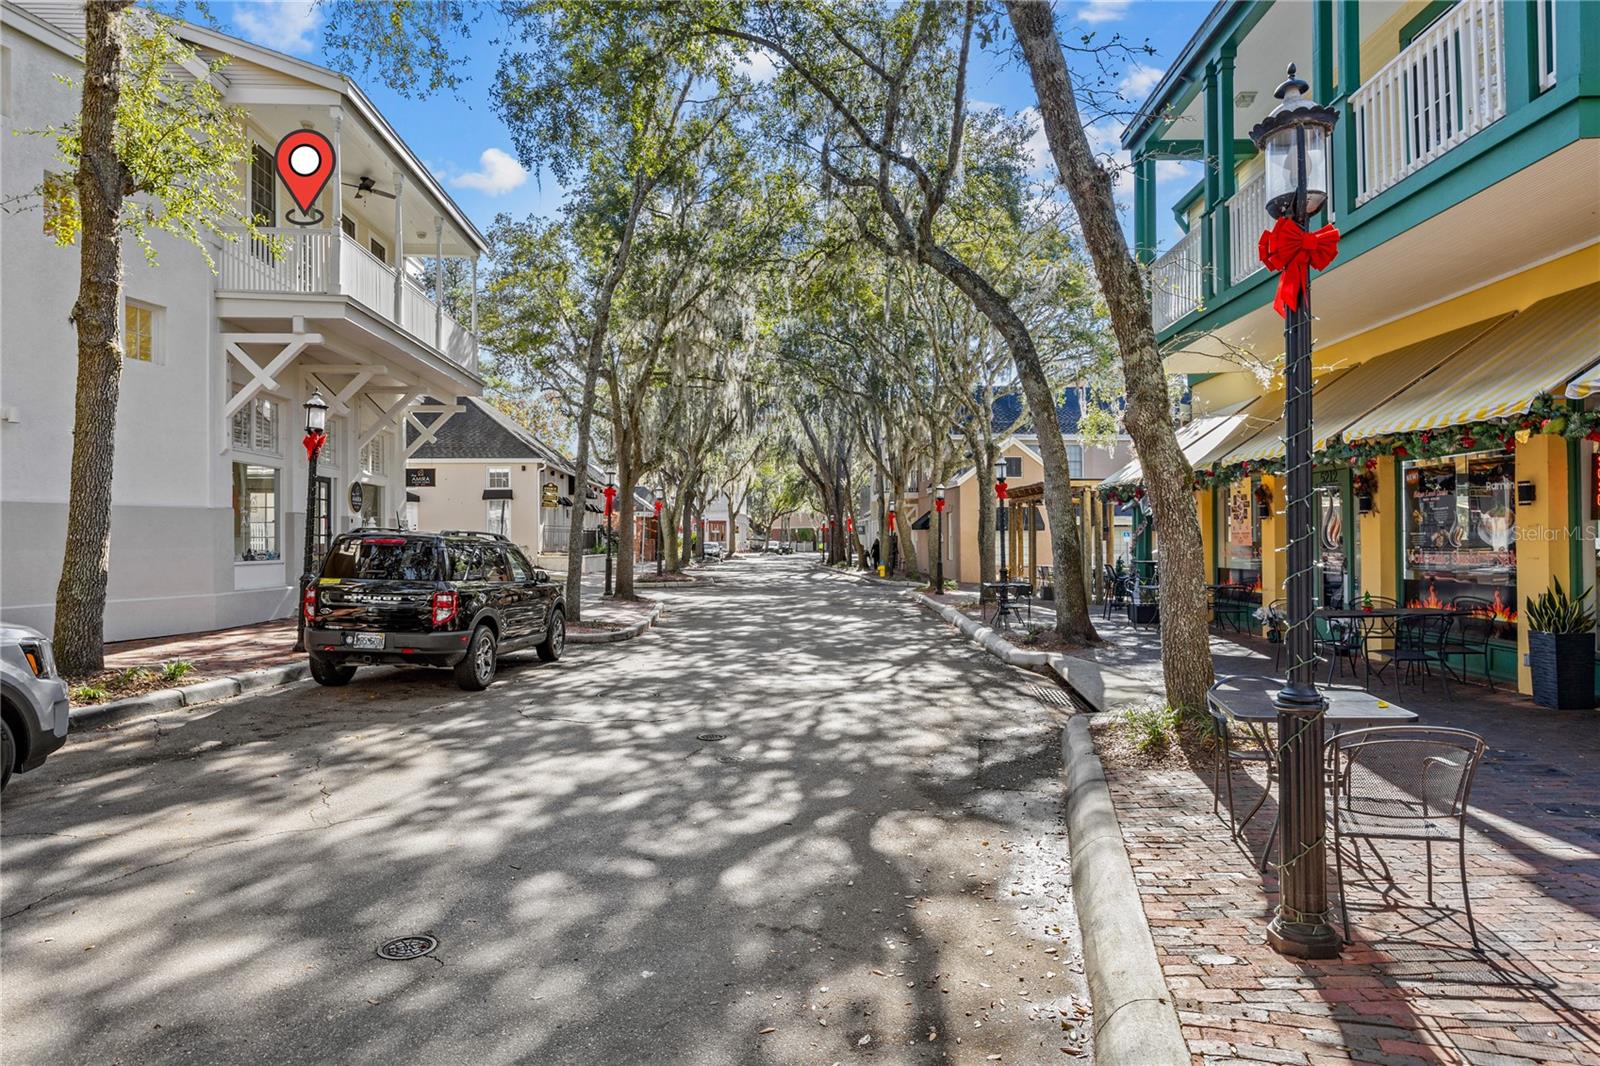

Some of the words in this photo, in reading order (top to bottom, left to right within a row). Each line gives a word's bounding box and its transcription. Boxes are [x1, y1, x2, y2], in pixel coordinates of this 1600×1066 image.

[1320, 471, 1338, 482] 5212
[1485, 481, 1515, 491] Ramen
[1451, 549, 1481, 566] Sushi
